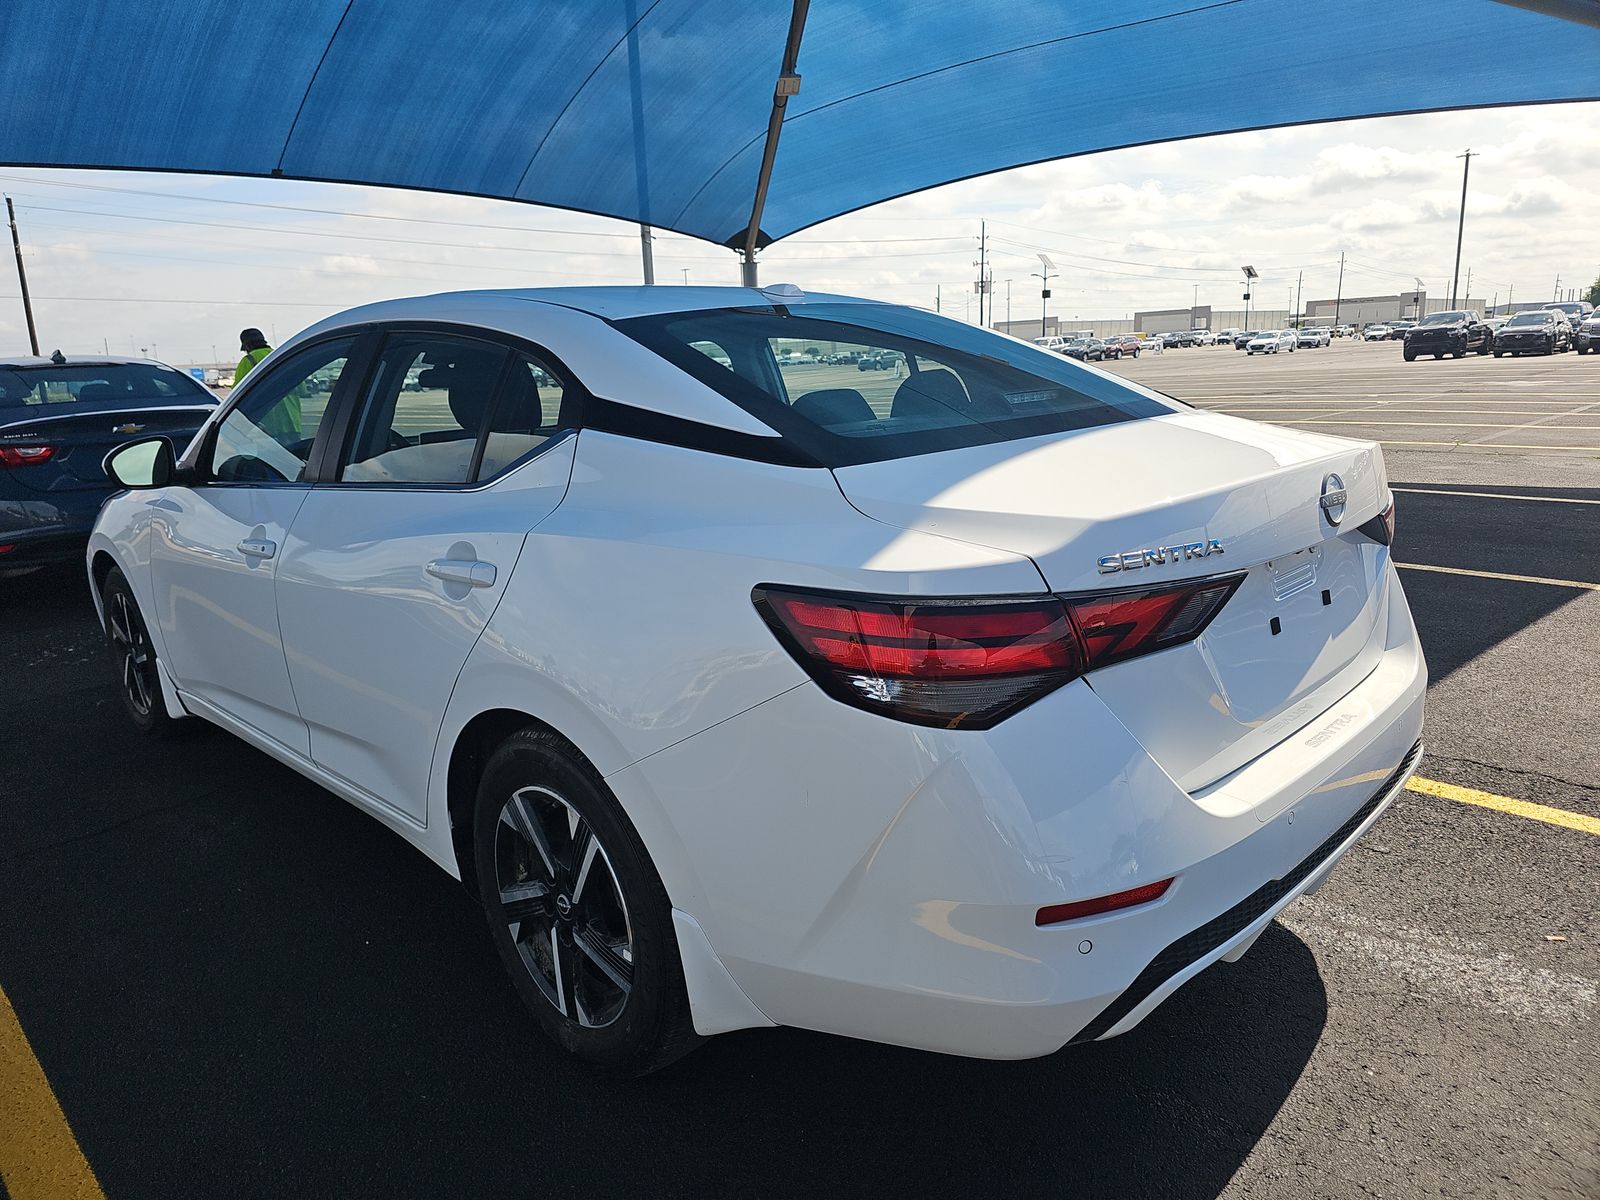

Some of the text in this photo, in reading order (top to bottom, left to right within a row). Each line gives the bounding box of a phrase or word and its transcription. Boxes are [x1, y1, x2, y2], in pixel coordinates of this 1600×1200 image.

[1322, 493, 1346, 506] NISS
[1097, 538, 1225, 575] SENTRA
[1304, 713, 1357, 748] SENTRA
